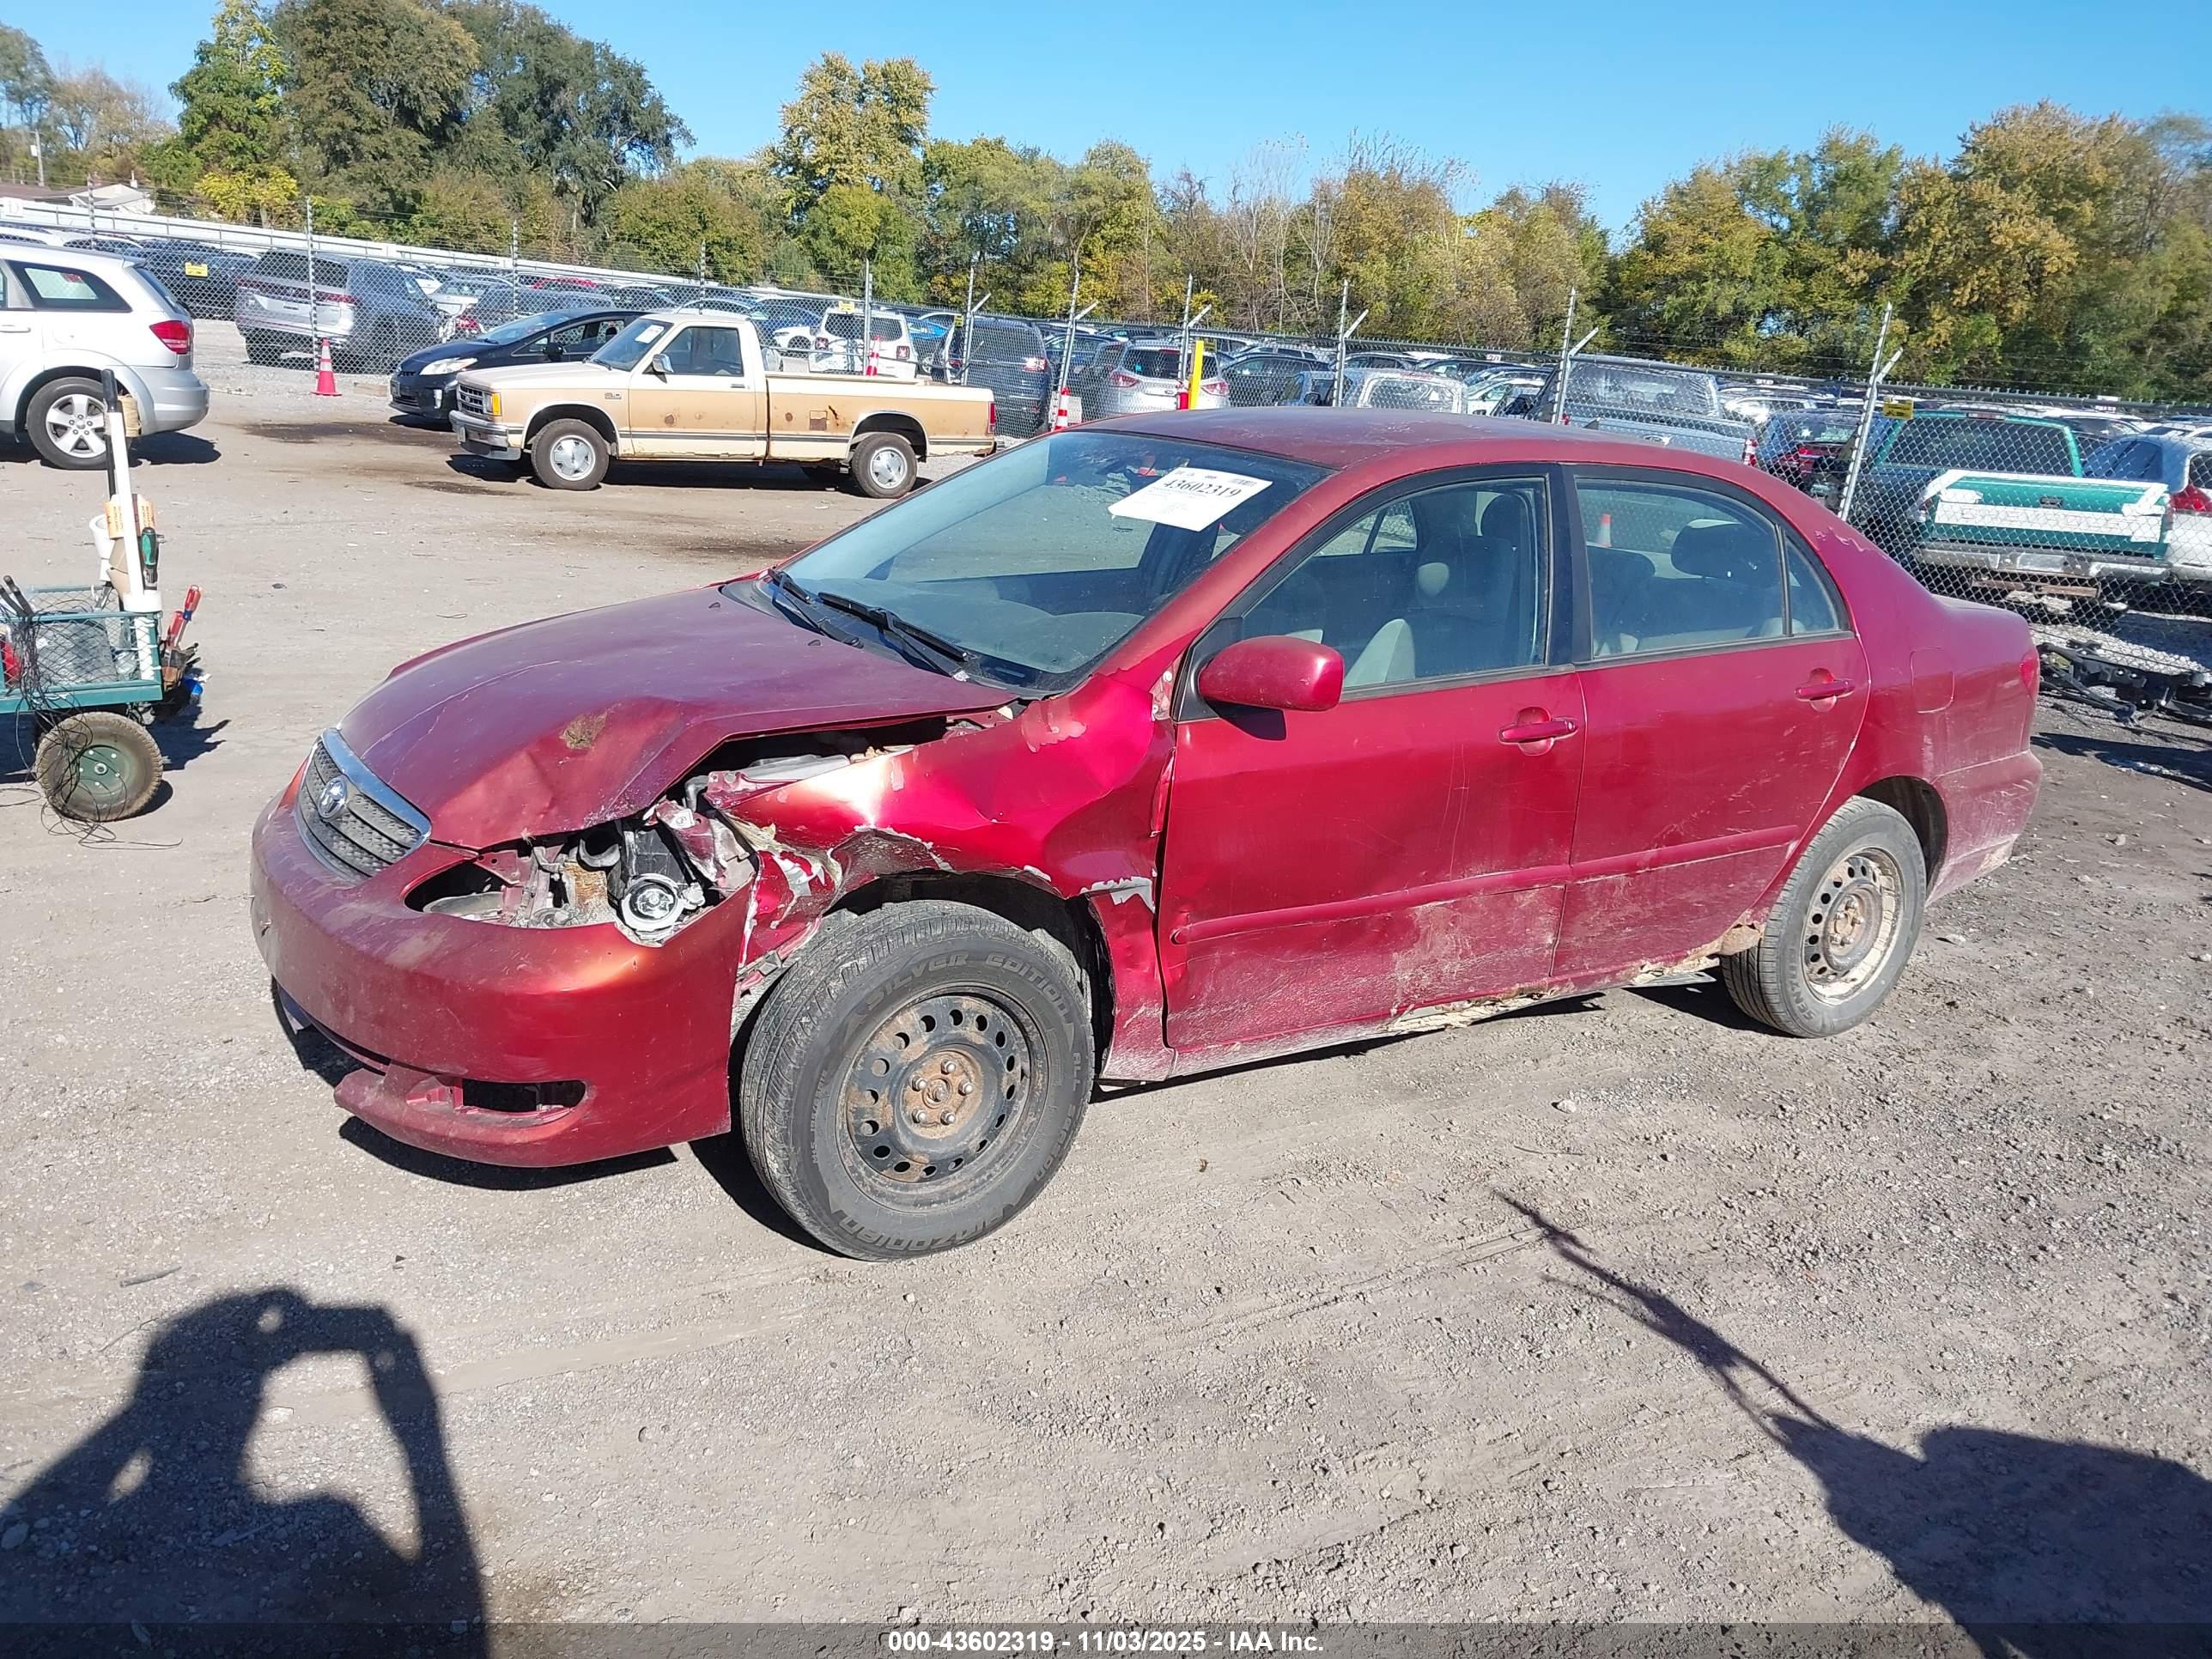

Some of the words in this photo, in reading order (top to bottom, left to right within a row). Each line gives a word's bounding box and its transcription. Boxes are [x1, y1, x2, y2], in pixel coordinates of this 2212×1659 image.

[1164, 478, 1243, 498] 43602319
[865, 951, 969, 1011] SILVER
[985, 951, 1070, 1018] EDITION
